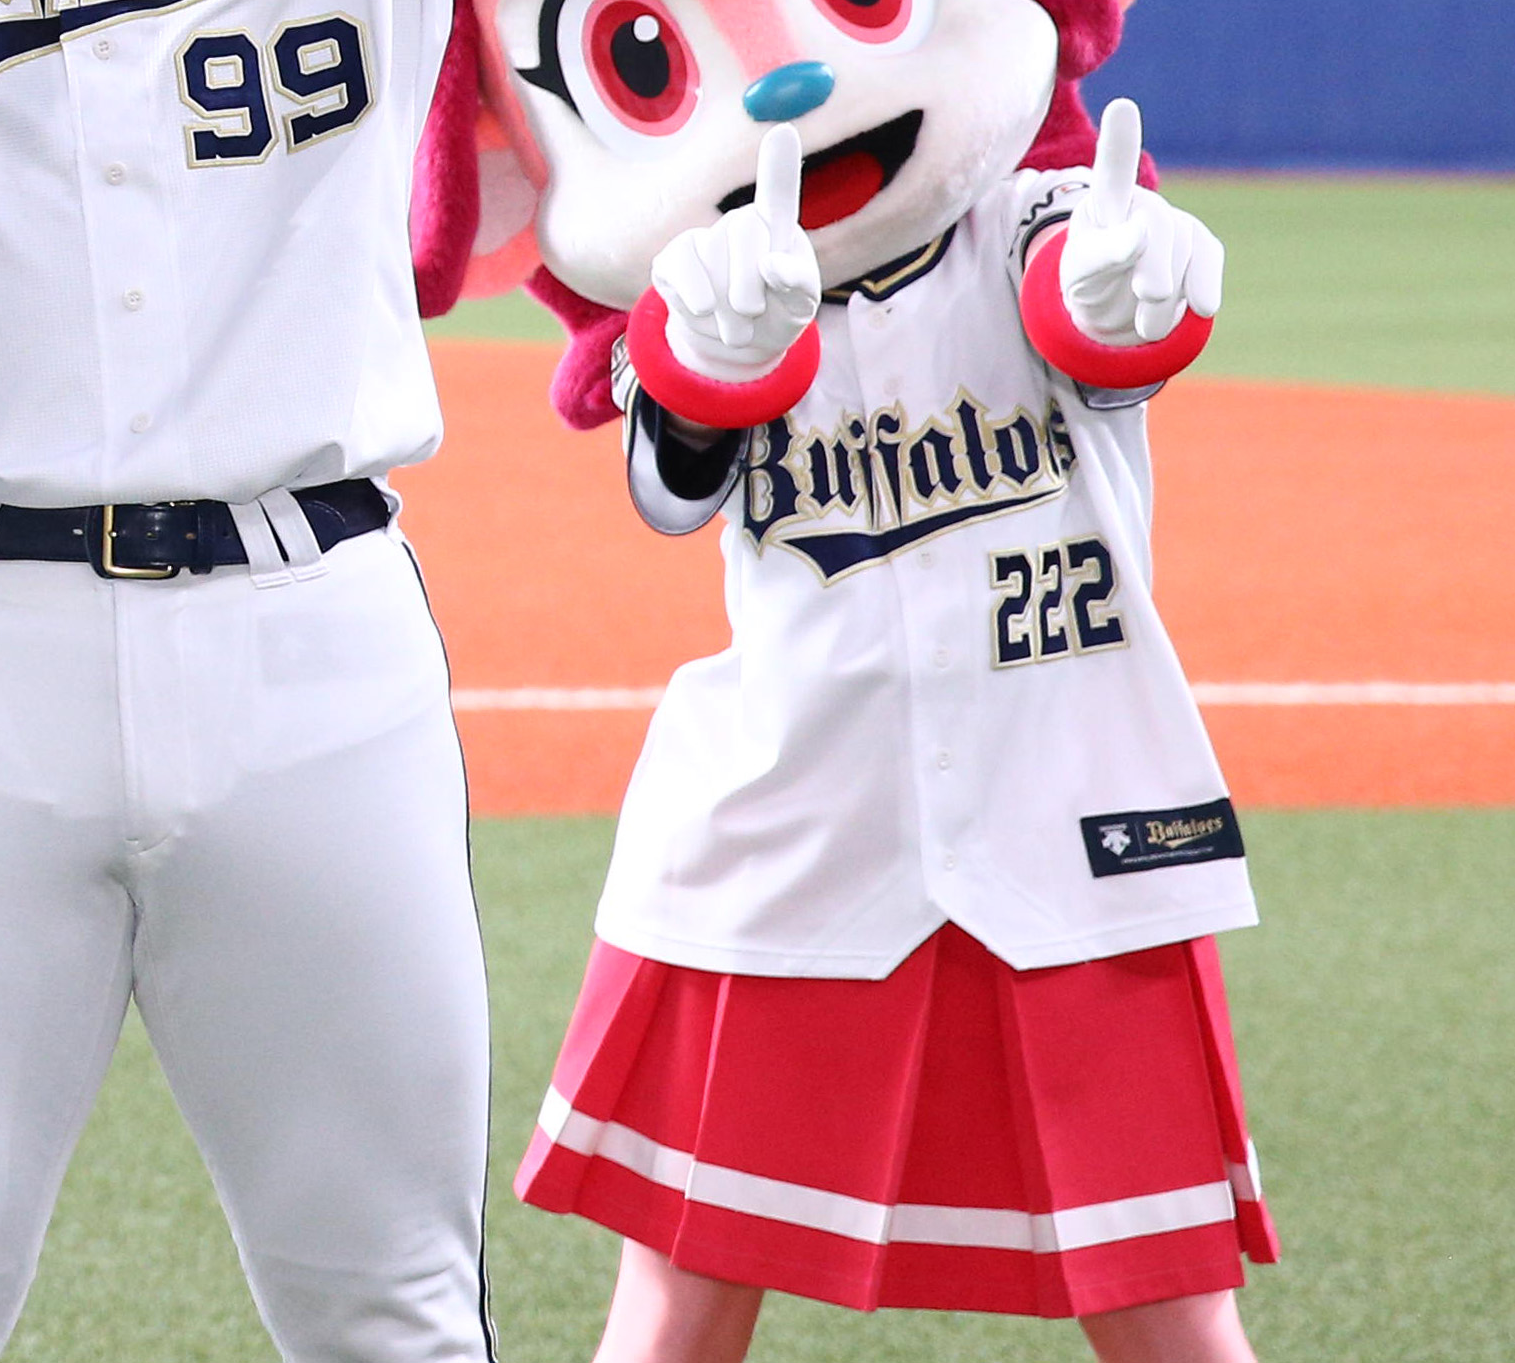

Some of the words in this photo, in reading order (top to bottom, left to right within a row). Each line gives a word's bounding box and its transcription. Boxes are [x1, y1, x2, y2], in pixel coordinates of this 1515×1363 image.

[173, 9, 378, 170] 99
[987, 535, 1131, 670] 222
[1145, 816, 1224, 846] Buffaloes
